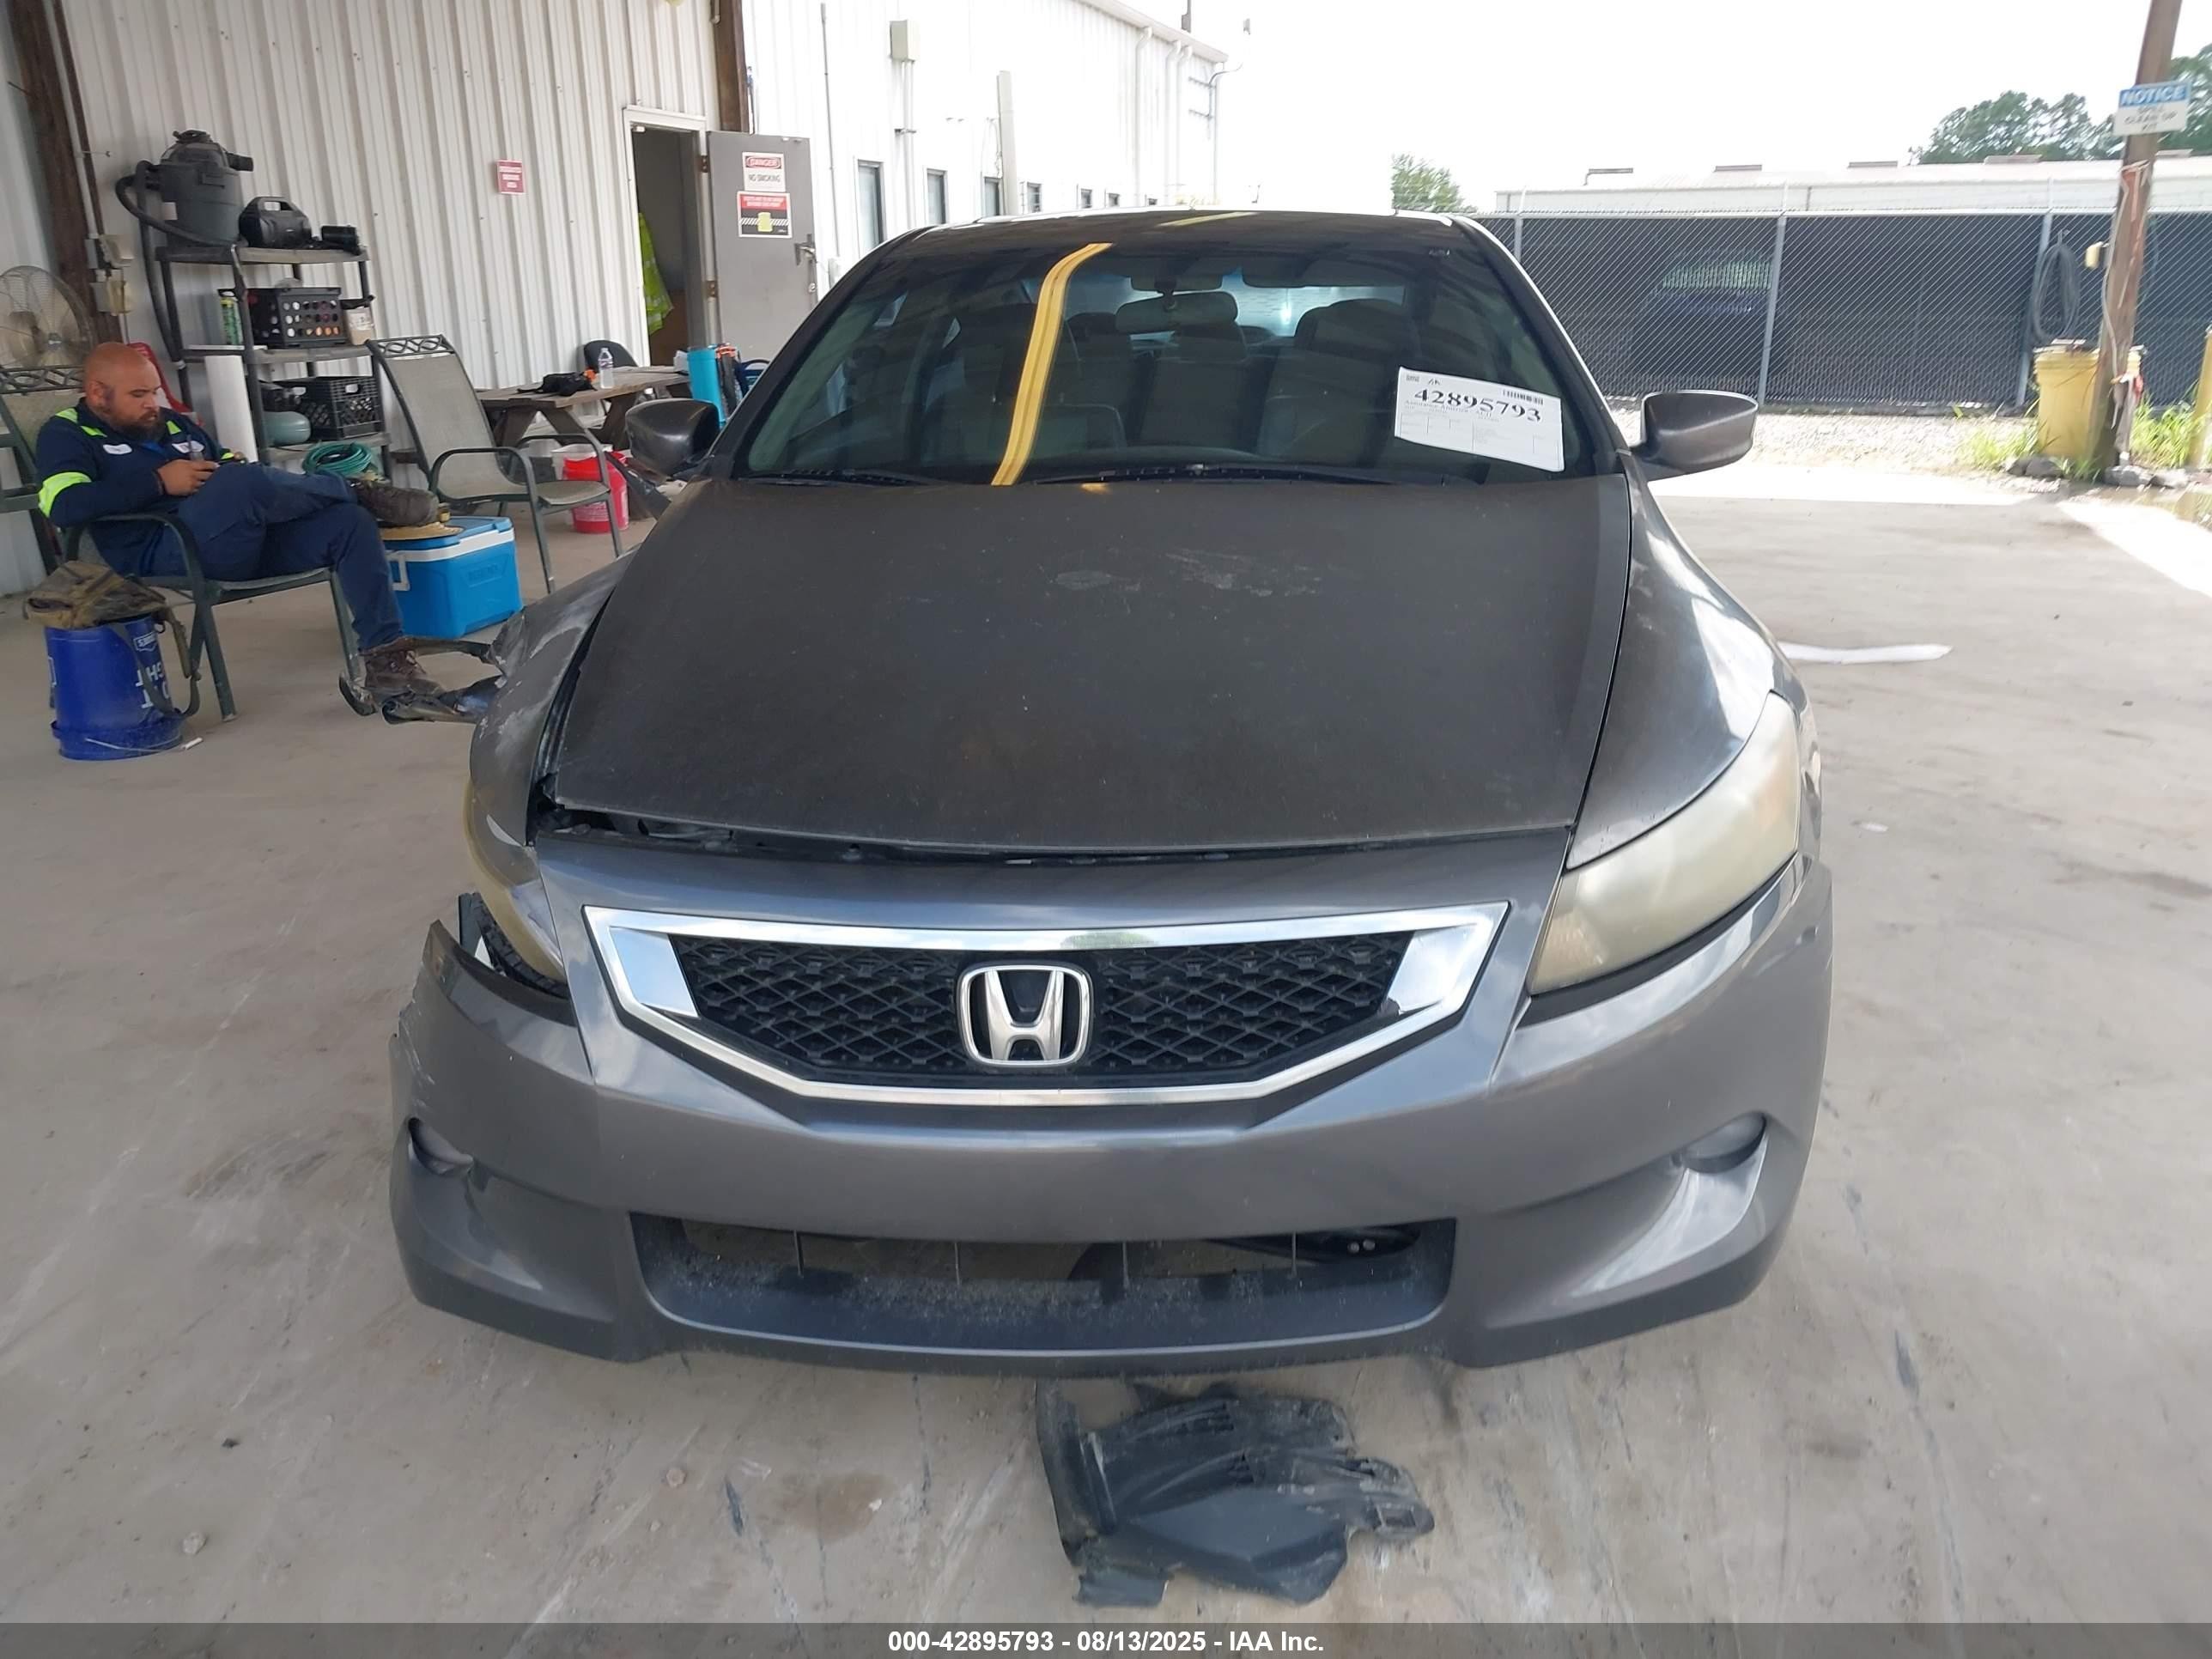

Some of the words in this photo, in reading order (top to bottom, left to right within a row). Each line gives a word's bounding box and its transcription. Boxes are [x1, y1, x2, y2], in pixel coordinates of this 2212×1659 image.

[2120, 85, 2186, 106] NOTICE
[749, 157, 779, 168] DANGER
[1414, 388, 1541, 422] 42895793
